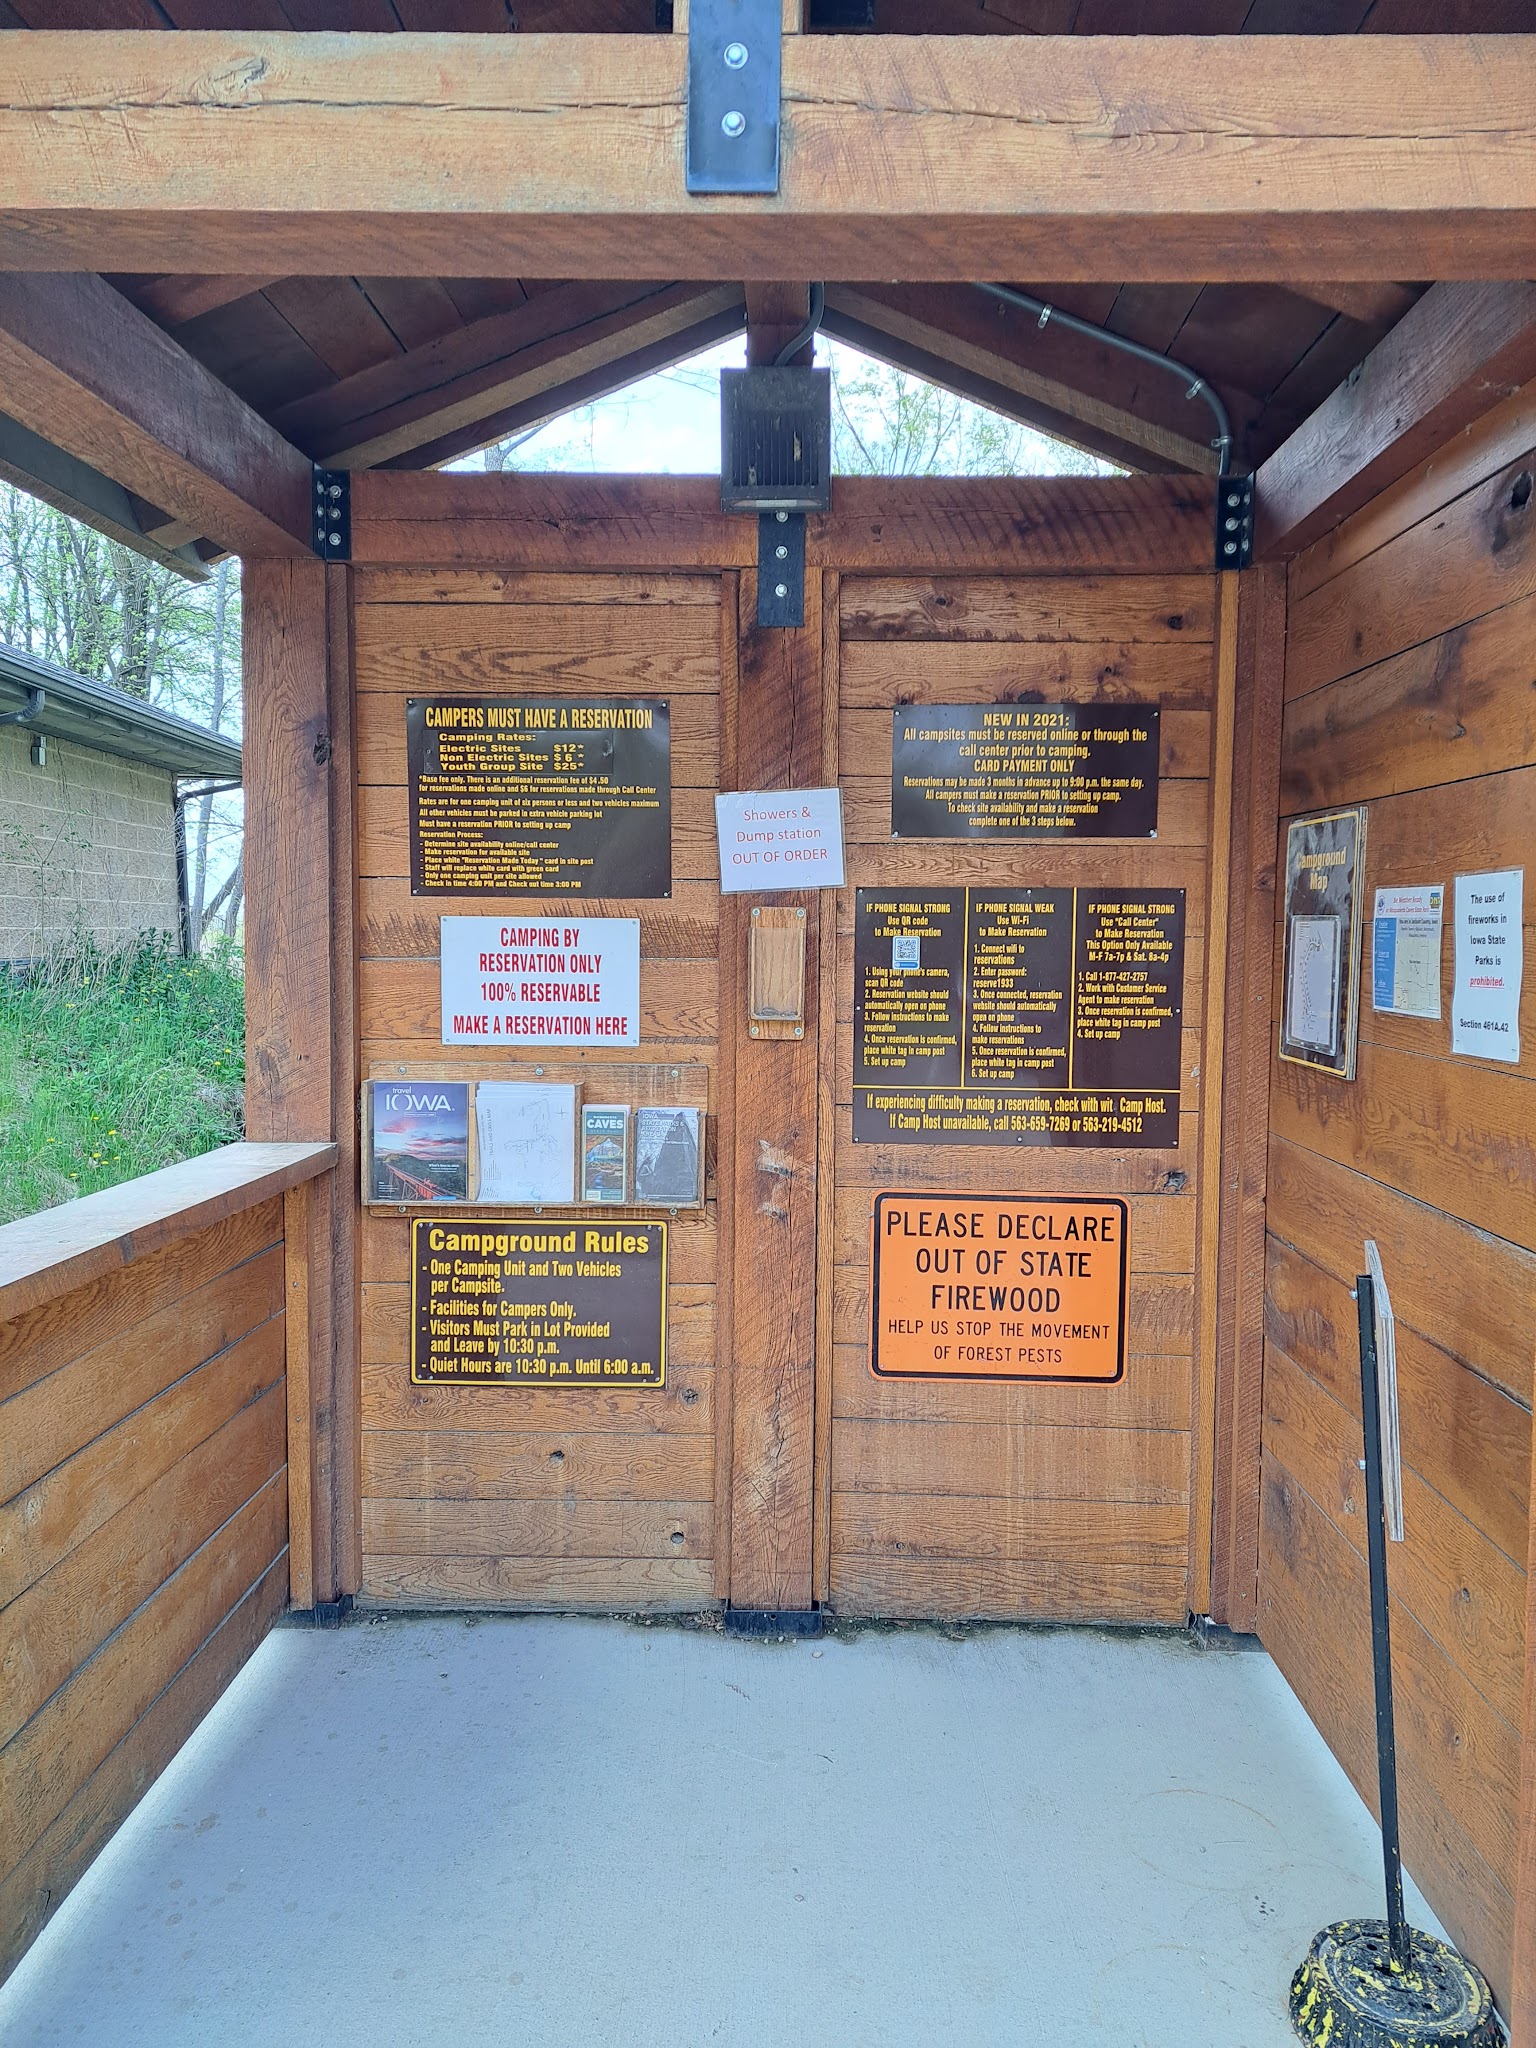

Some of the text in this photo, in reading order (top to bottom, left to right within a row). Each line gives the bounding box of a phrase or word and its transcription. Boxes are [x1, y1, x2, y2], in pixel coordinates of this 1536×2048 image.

[425, 706, 652, 728] CAMPERS MUST HAVE A RESERVATION
[983, 713, 1069, 726] NEW IN 2021:
[439, 732, 536, 742] Camping Rates:
[903, 728, 1147, 743] All campsites must be reserved online or through the
[439, 744, 486, 752] Electric
[490, 744, 521, 752] Sites
[958, 743, 1090, 759] call center prior to camping.
[439, 753, 548, 761] Non Electric Sites
[440, 762, 475, 770] Youth
[479, 762, 515, 772] Group
[519, 762, 543, 770] Site
[974, 759, 1074, 772] CARD PAYMENT ONLY
[743, 806, 811, 821] Showers &
[736, 828, 820, 842] Dump station
[732, 848, 827, 864] OUT OF ORDER
[1296, 846, 1346, 870] Campground
[570, 880, 581, 888] PM
[1310, 872, 1328, 892] Map
[1470, 891, 1505, 904] The use of
[975, 903, 1054, 913] IF PHONE SIGNAL WEAK
[1467, 913, 1507, 924] fireworks in
[500, 927, 579, 947] CAMPING BY
[1470, 934, 1505, 944] Iowa State
[479, 953, 601, 973] RESERVATION ONLY
[1474, 954, 1501, 965] Parks is
[972, 978, 1013, 988] reserve1933
[1085, 971, 1097, 981] Call
[1098, 971, 1148, 981] 1-877-427-2757
[1469, 975, 1504, 987] prohibited.
[481, 982, 600, 1002] 100% RESERVABLE
[453, 1015, 627, 1035] MAKE A RESERVATION HERE
[1459, 1018, 1508, 1032] Section 461A.42
[392, 1086, 411, 1094] travel
[587, 1119, 623, 1129] CAVES
[889, 1112, 1142, 1132] If Camp Host unavailable, call 563-659-7269 or 563-219-4512
[887, 1210, 1114, 1242] PLEASE DECLARE
[429, 1228, 648, 1256] Campground Rules
[430, 1259, 621, 1278] One Camping Unit and Two Vehicles
[916, 1248, 1091, 1277] OUT OF STATE
[431, 1278, 504, 1296] per Campsite.
[931, 1284, 1060, 1312] FIREWOOD
[430, 1299, 576, 1320] Facilities for Campers Only.
[429, 1320, 610, 1338] Visitors Must Park in Lot Provided
[888, 1319, 1110, 1339] HELP US STOP THE MOVEMENT
[430, 1338, 559, 1357] and Leave by 10:30 p.m.
[934, 1345, 1061, 1363] OF FOREST PESTS
[429, 1356, 654, 1376] Quiet Hours are 10:30 p.m. Until 6:00 a.m.
